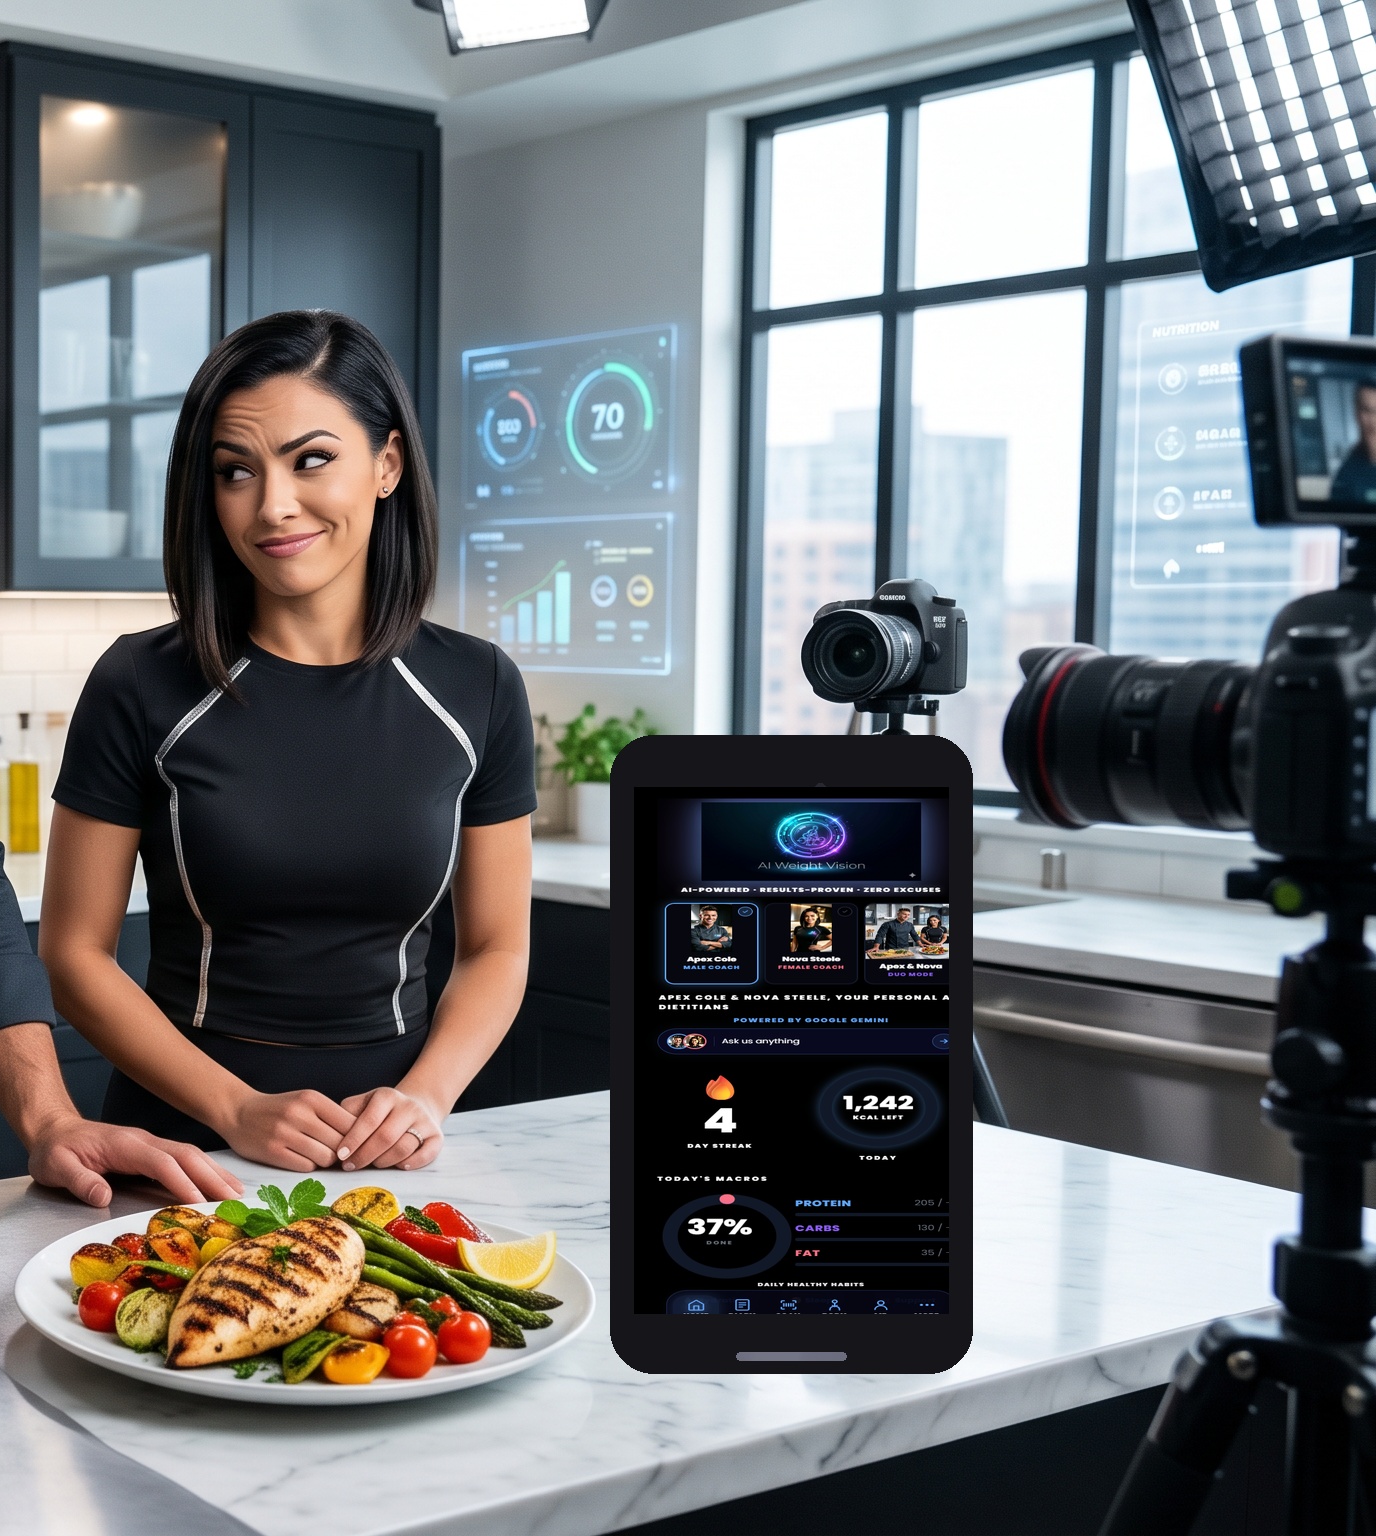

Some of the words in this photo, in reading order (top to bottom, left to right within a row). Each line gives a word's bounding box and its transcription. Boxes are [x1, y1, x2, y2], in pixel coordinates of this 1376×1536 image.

[1151, 319, 1220, 339] NUTRITION
[591, 402, 625, 432] 70
[757, 861, 772, 870] AI
[774, 861, 825, 873] Weight
[825, 861, 867, 870] Vision
[686, 955, 713, 964] Apex
[878, 962, 906, 971] Apex
[783, 994, 831, 1002] STEELE,
[754, 1037, 801, 1046] anything
[842, 1094, 915, 1113] 1,242
[703, 1107, 738, 1134] 4
[794, 1199, 852, 1207] PROTEIN
[913, 1198, 936, 1206] 205
[687, 1217, 753, 1236] 37%
[794, 1224, 841, 1232] CARBS
[916, 1223, 936, 1231] 130
[794, 1249, 821, 1257] FAT
[920, 1248, 936, 1256] 35
